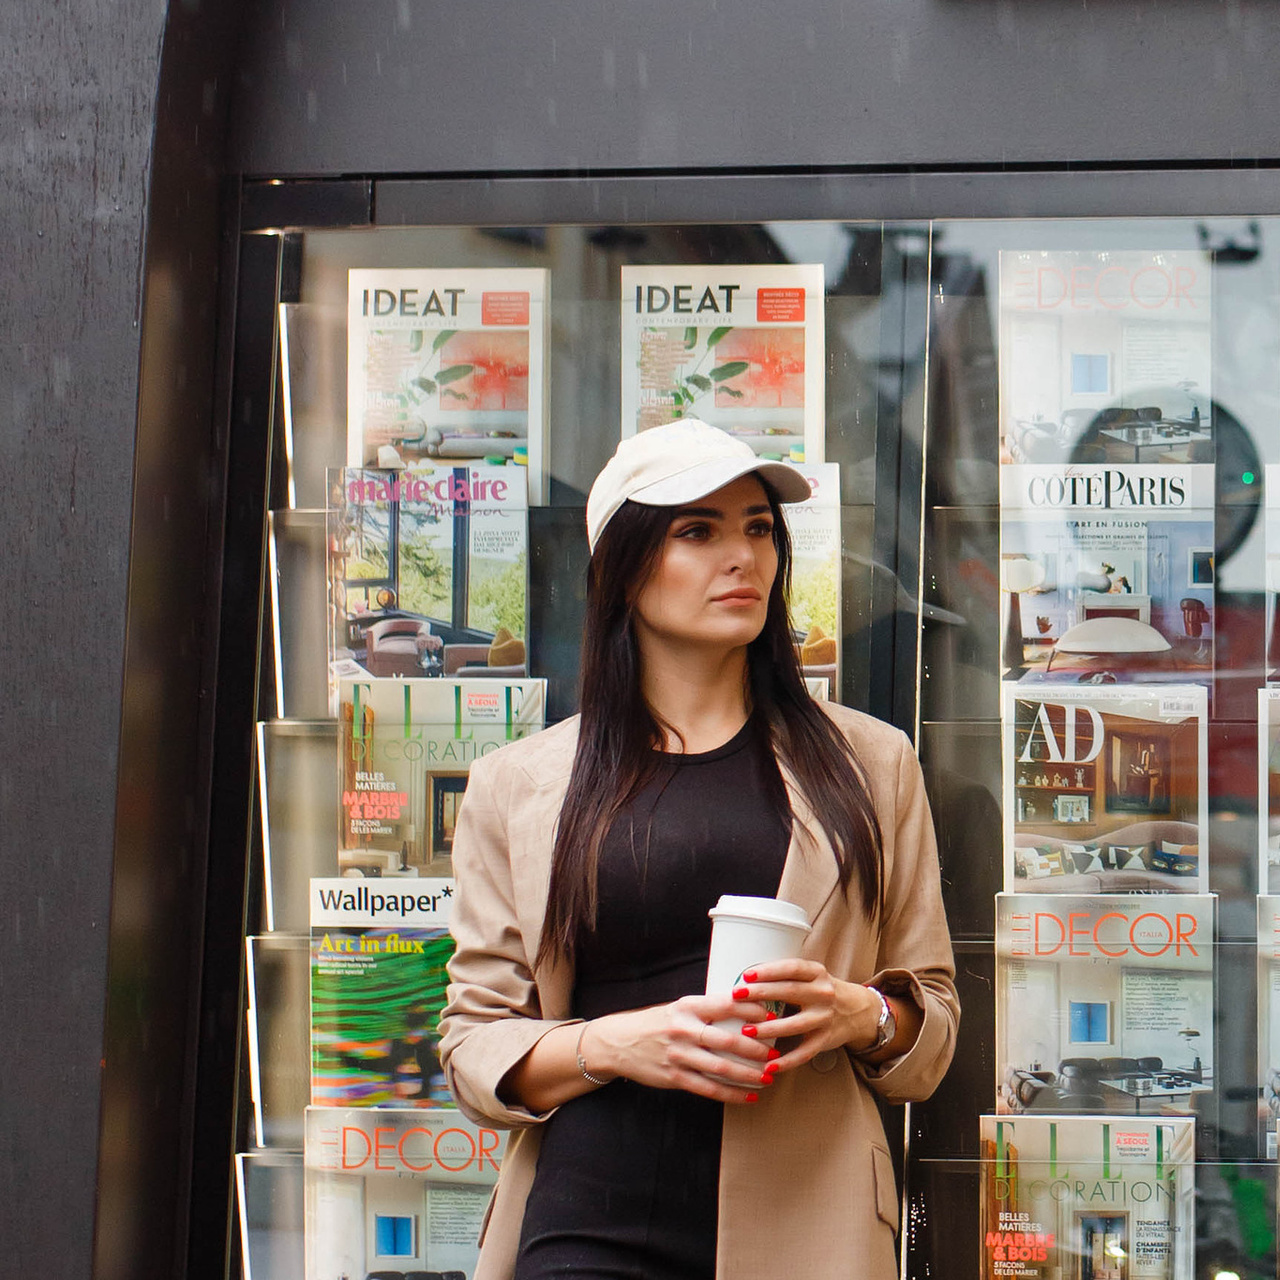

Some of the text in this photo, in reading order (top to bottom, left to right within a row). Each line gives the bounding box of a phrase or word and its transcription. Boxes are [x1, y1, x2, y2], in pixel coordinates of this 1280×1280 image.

[636, 285, 740, 313] IDEAT
[1037, 266, 1199, 310] DECOR
[362, 289, 465, 317] IDEAT
[352, 683, 524, 740] ELLE
[1018, 702, 1105, 763] AD
[355, 772, 384, 782] BELLES
[342, 790, 409, 806] MARBRE
[349, 805, 401, 819] & BOIS
[319, 933, 425, 954] Art in flux
[1034, 912, 1200, 957] DECOR
[342, 1127, 500, 1172] DECOR
[992, 1121, 1176, 1180] ELLE
[998, 1212, 1029, 1221] BELLES
[985, 1232, 1056, 1248] MARBRE
[993, 1247, 1048, 1261] & BOIS
